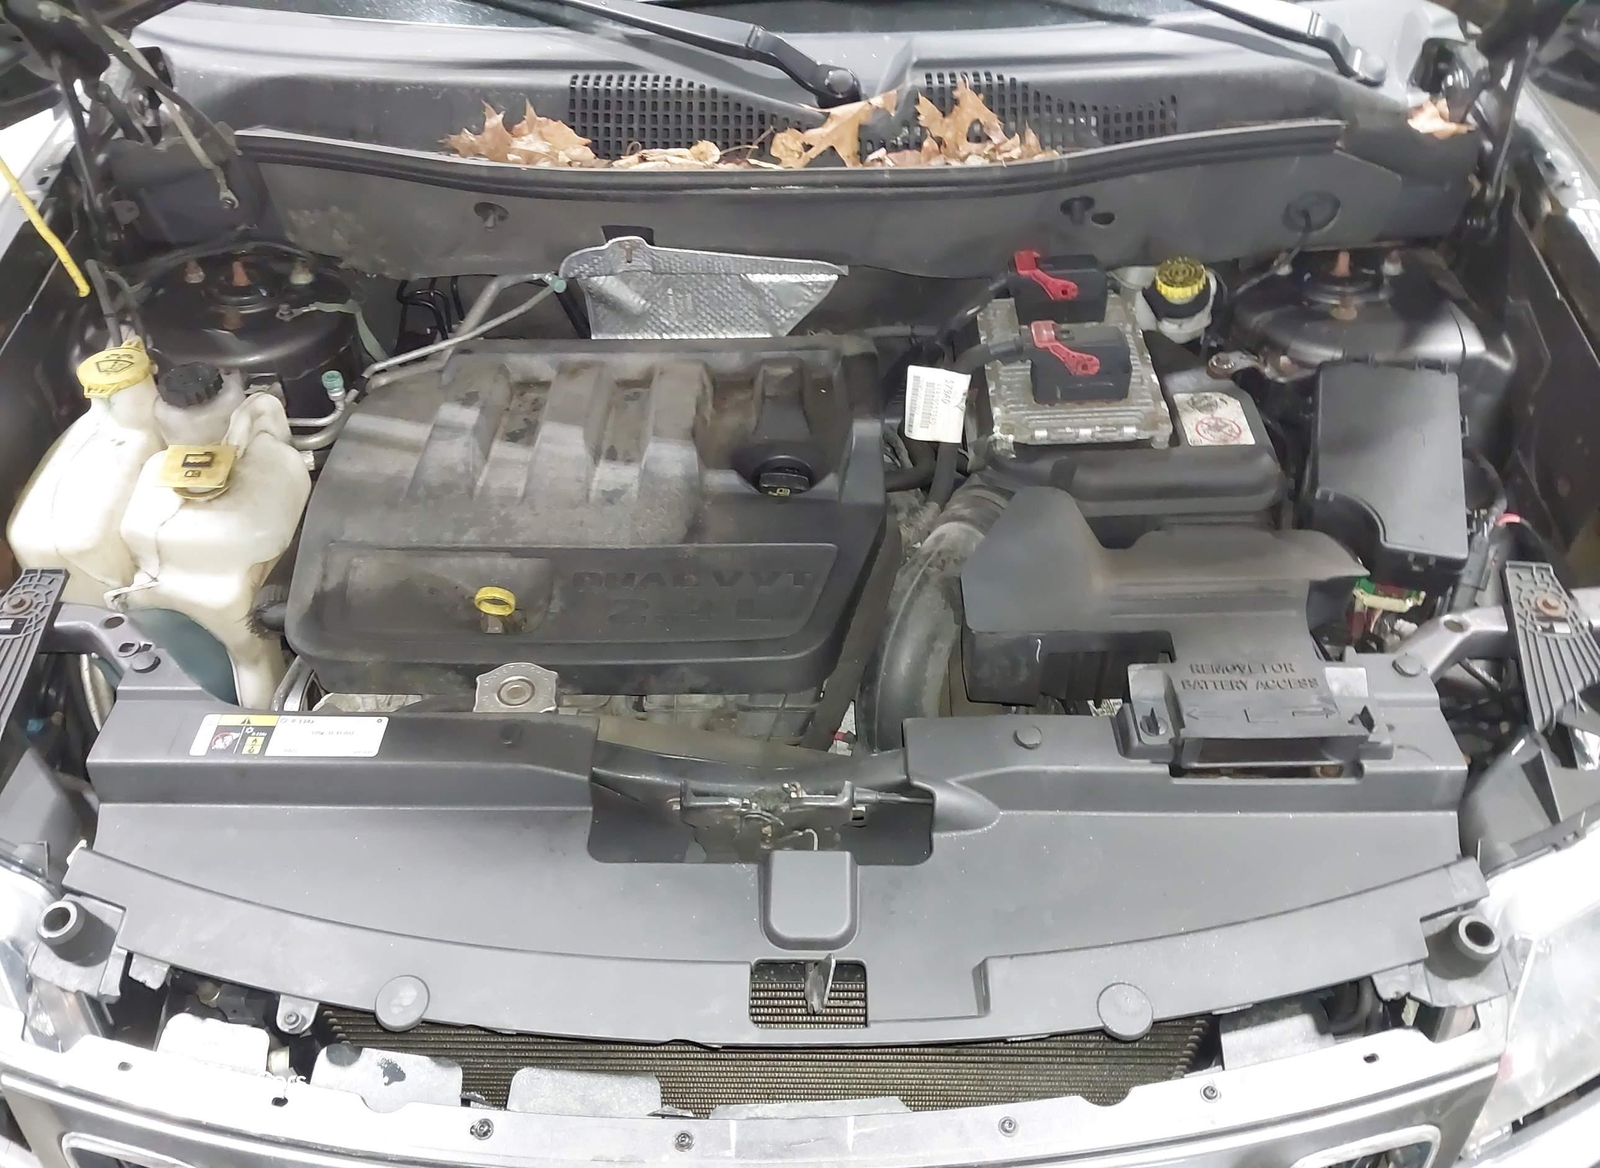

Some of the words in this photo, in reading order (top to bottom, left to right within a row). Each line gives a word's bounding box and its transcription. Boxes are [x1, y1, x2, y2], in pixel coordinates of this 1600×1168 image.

[711, 570, 814, 588] VVT
[1188, 663, 1254, 674] REMOVE
[1262, 662, 1296, 674] FOR
[1180, 679, 1249, 691] BATTERY
[1255, 677, 1320, 690] ACCESS
